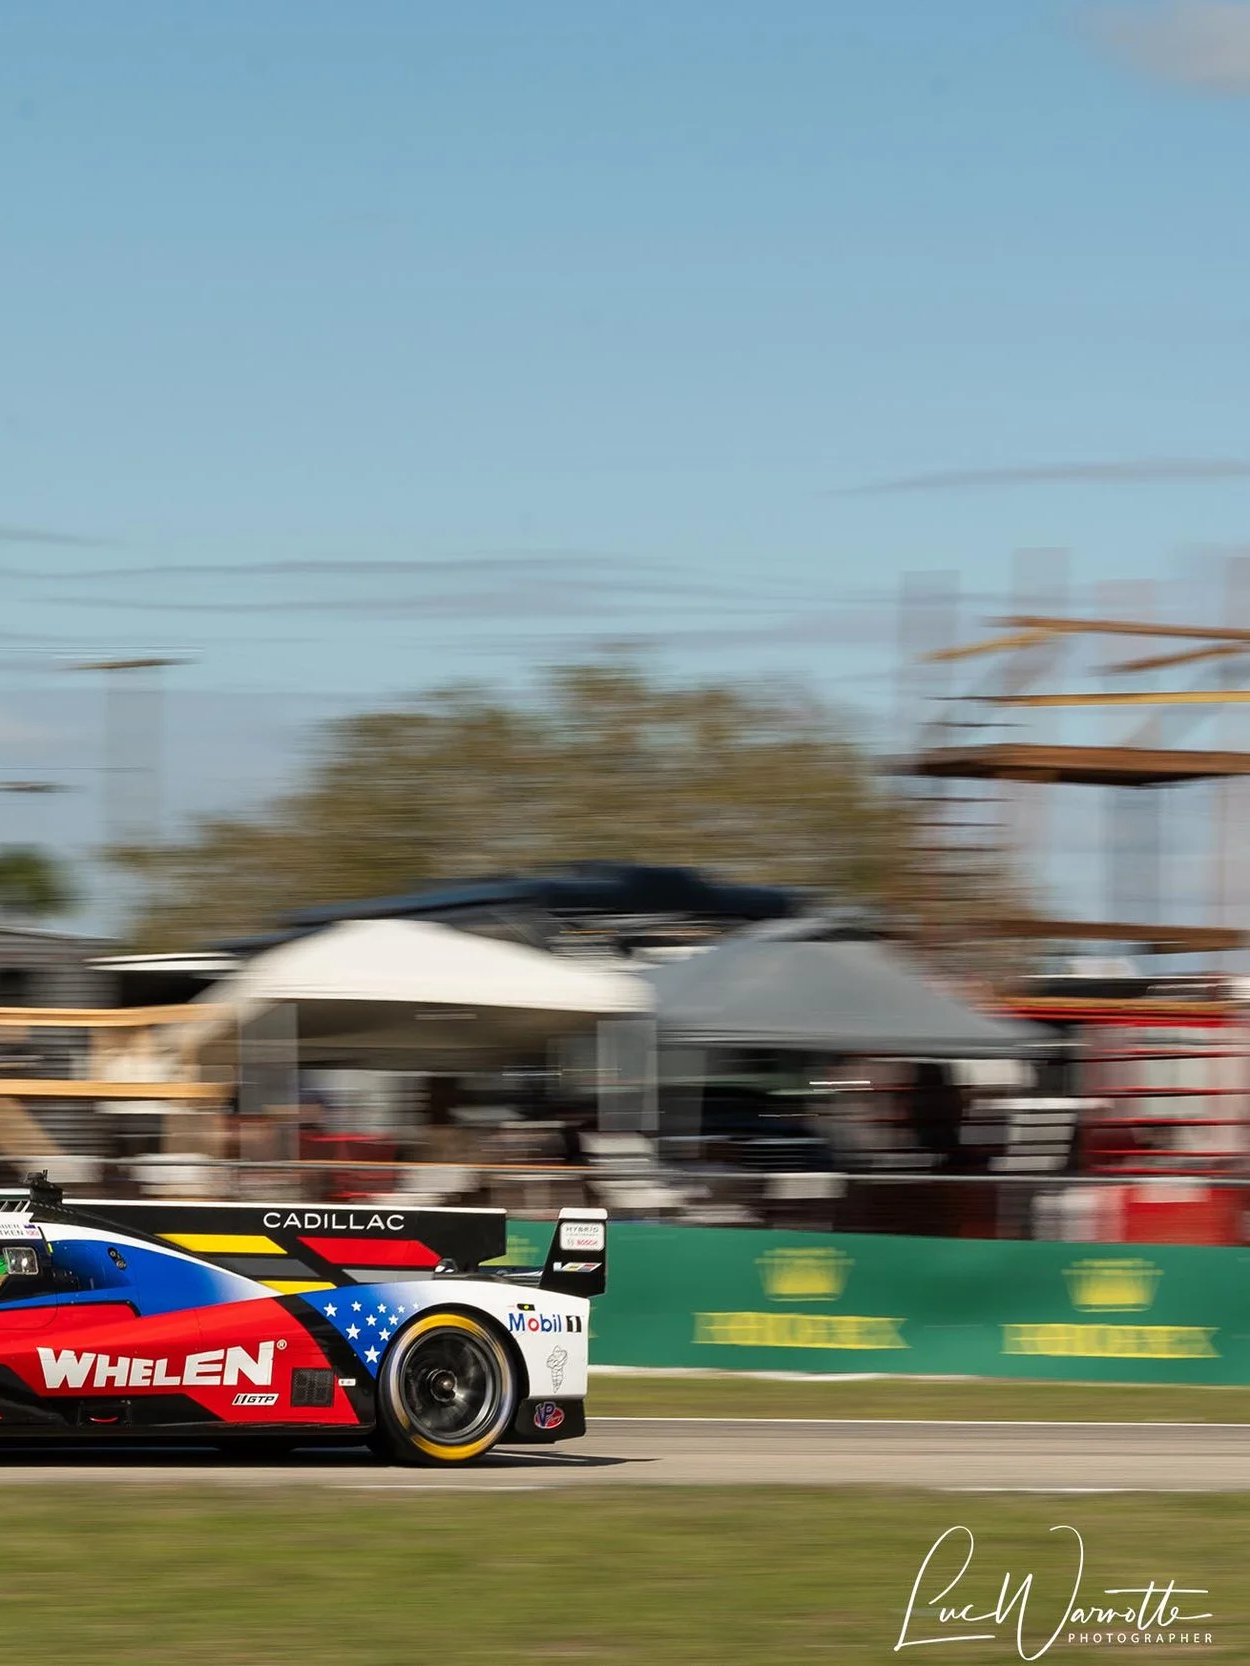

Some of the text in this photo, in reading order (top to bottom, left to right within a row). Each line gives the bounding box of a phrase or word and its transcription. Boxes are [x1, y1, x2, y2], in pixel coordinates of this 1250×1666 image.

[263, 1212, 405, 1231] CADILLAC
[508, 1313, 582, 1333] Mobil 1
[247, 1395, 275, 1404] GTP
